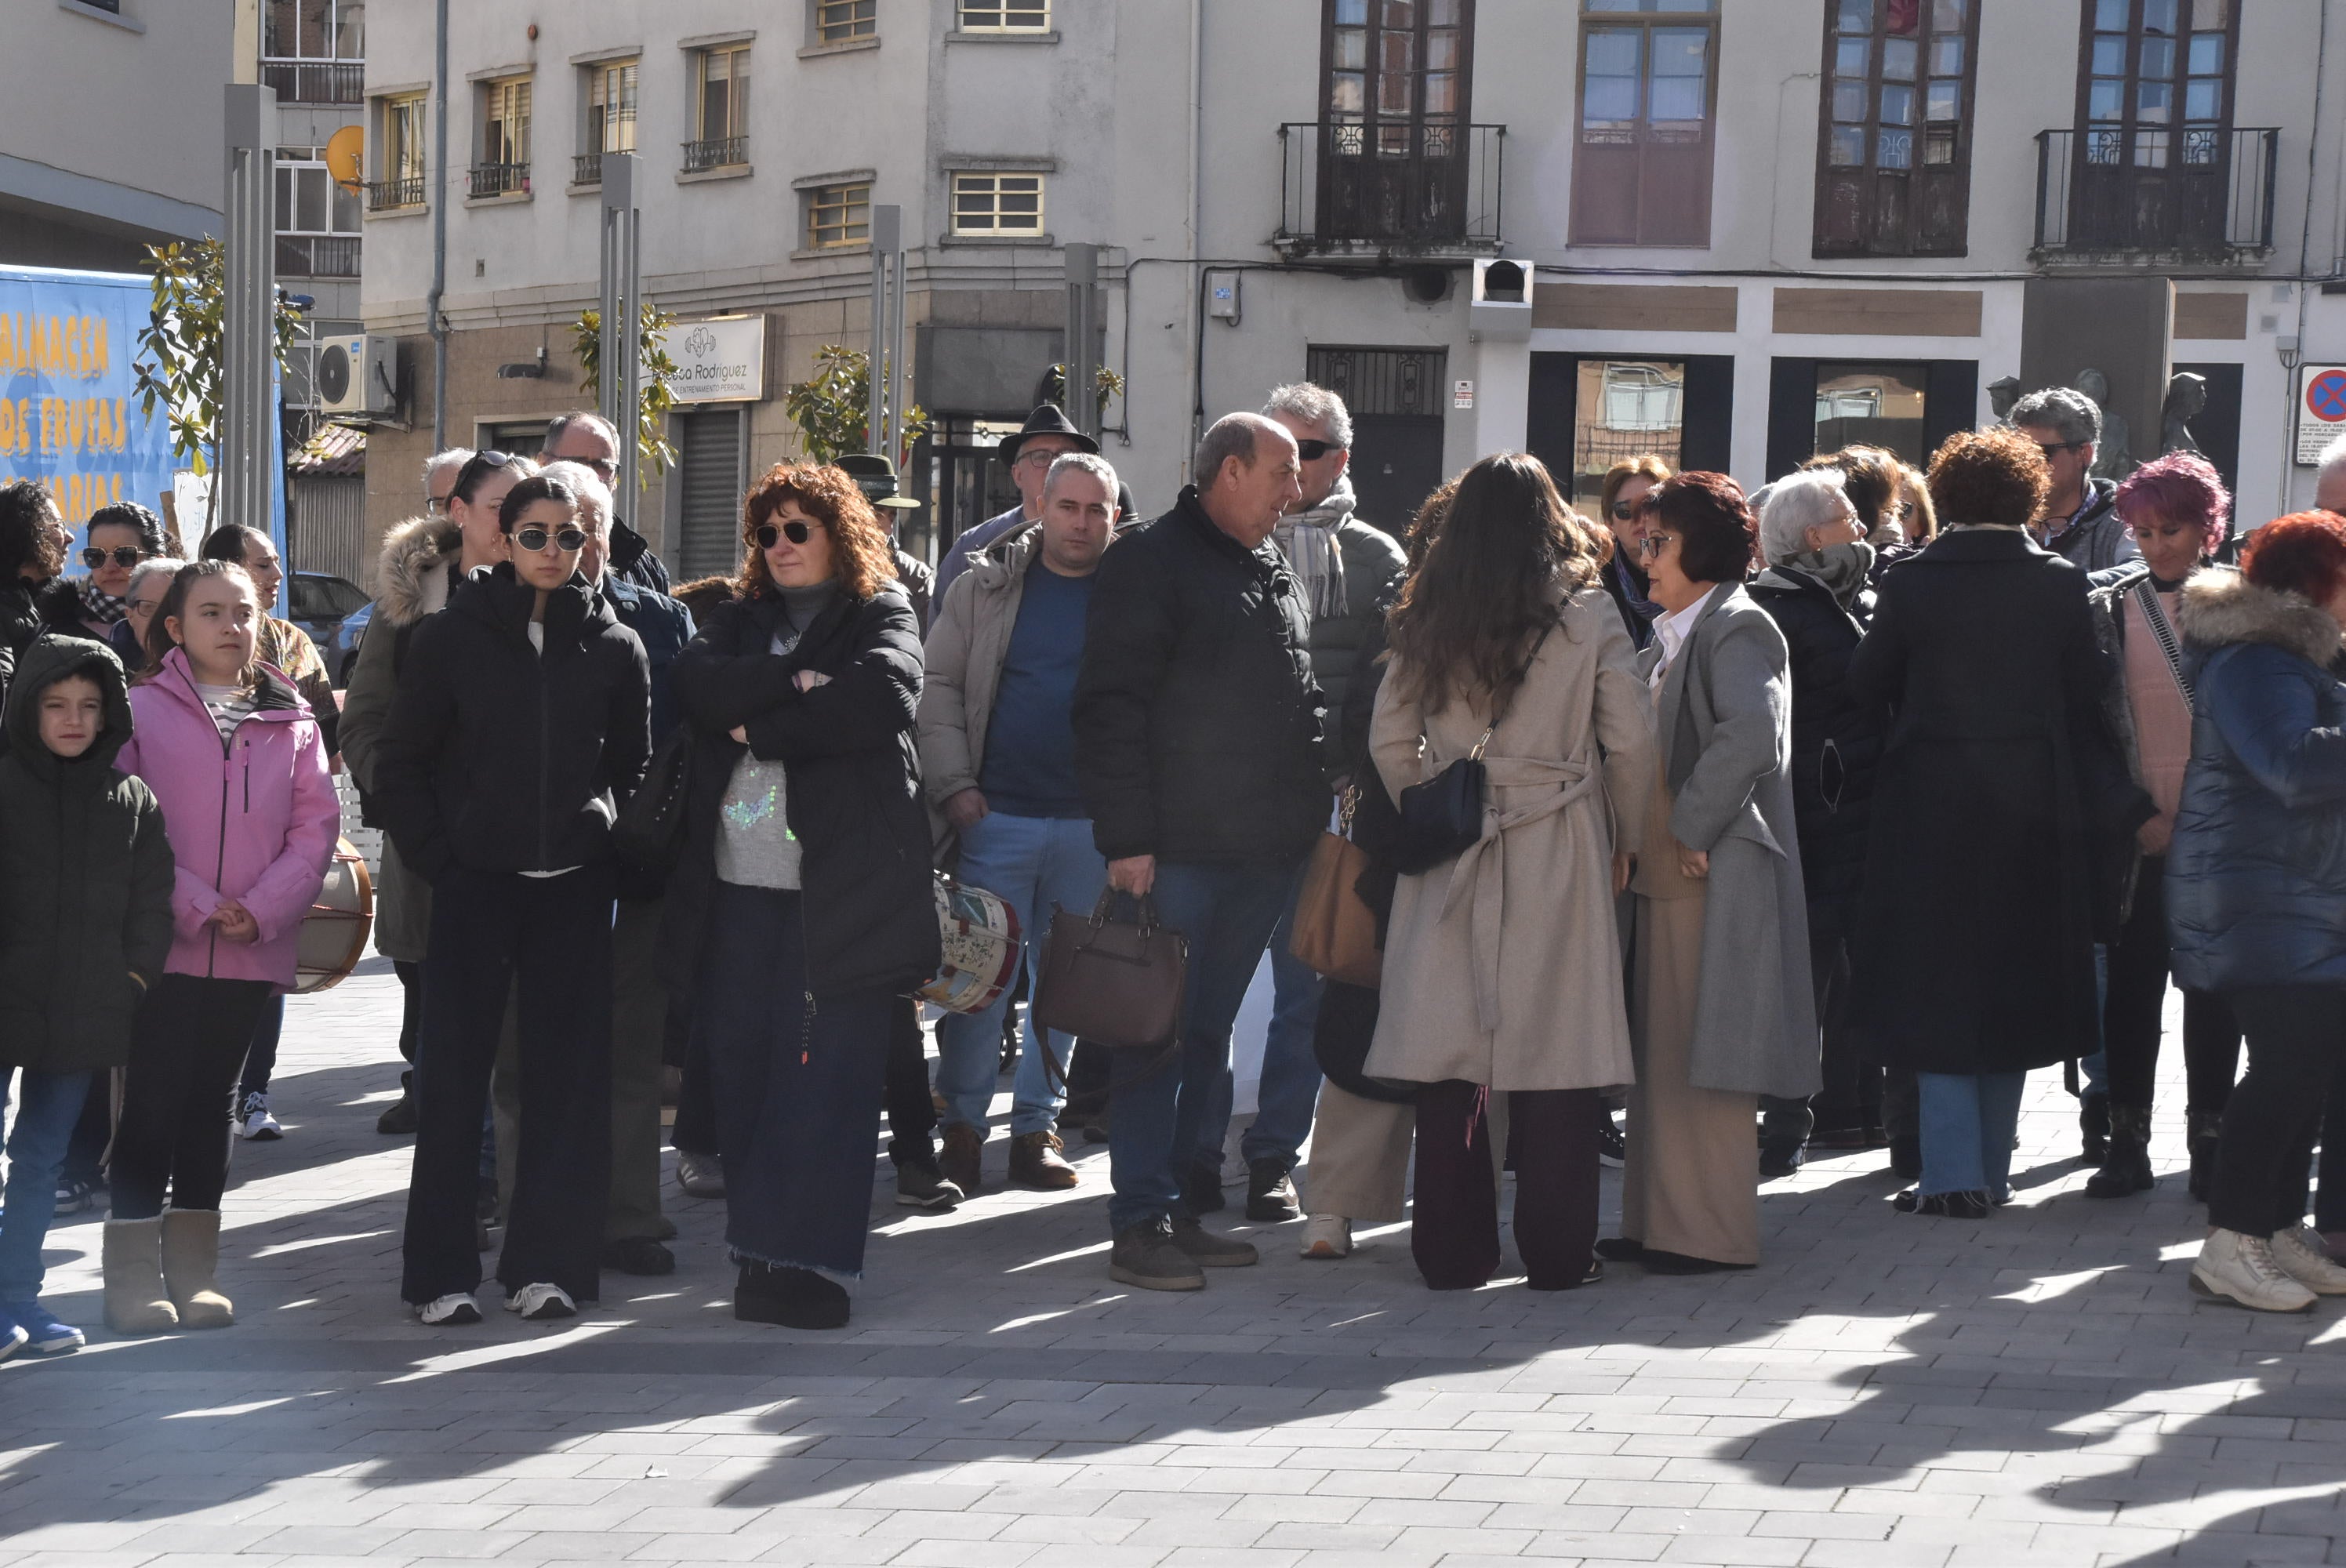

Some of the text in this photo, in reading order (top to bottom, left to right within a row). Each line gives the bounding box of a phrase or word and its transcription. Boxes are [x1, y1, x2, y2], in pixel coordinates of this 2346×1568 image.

[695, 363, 747, 381] Rodríguez
[680, 384, 720, 394] ENTRENAMIENTO
[0, 395, 126, 456] DE FRUTAS
